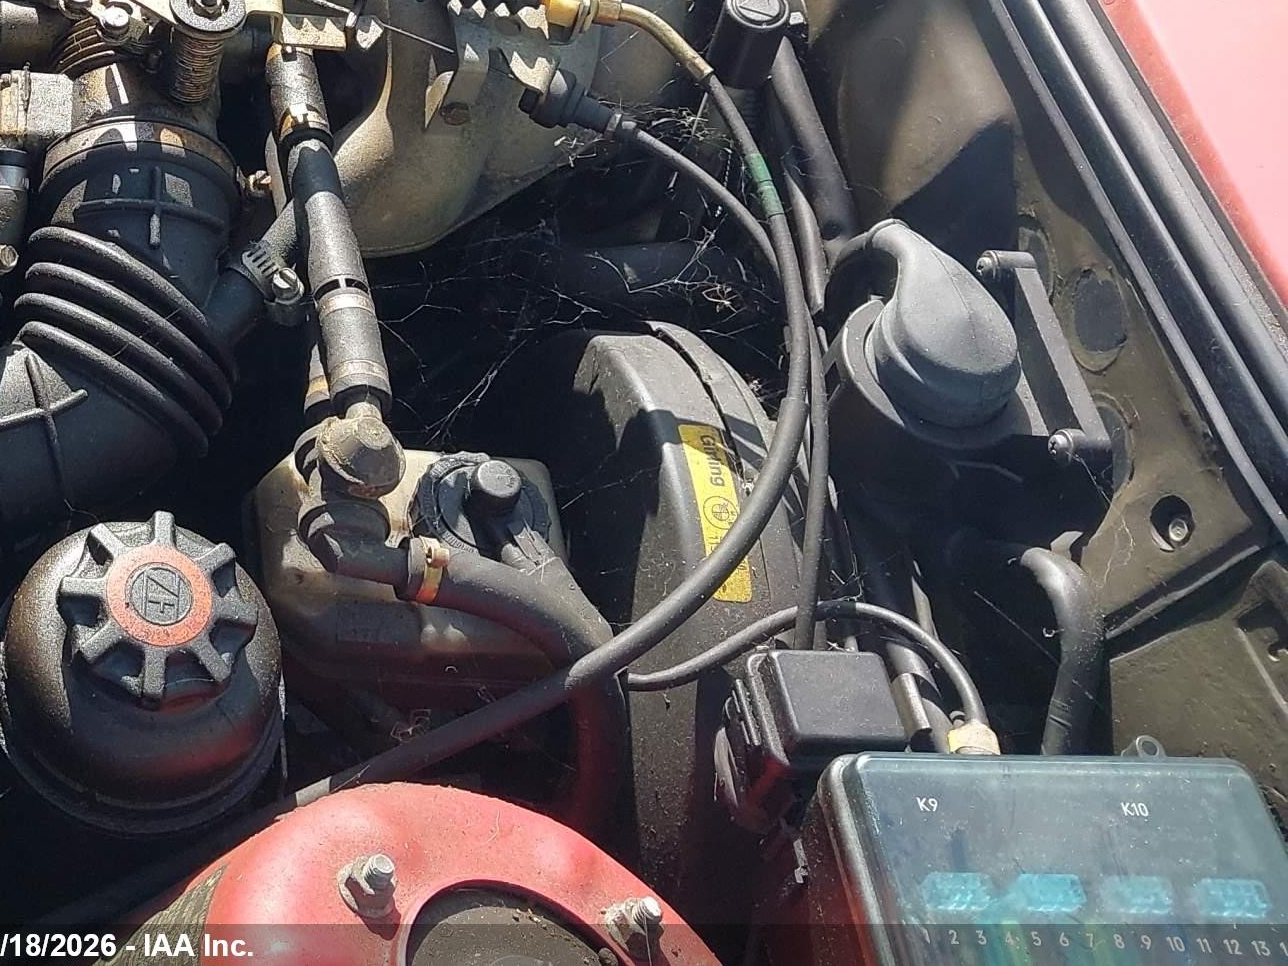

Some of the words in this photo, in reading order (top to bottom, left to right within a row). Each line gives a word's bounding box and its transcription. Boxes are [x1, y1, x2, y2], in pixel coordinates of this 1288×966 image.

[700, 435, 726, 487] Girling
[917, 796, 938, 813] K9
[1121, 800, 1149, 818] K10
[948, 930, 960, 945] 2
[975, 930, 987, 945] 3
[1031, 931, 1042, 946] 5
[1059, 932, 1070, 946] 6
[1113, 934, 1126, 949] 8
[1141, 935, 1152, 950] 9
[1166, 936, 1185, 952] 10
[1196, 937, 1212, 953] 11
[1223, 939, 1242, 955] 12
[1251, 940, 1271, 956] 13
